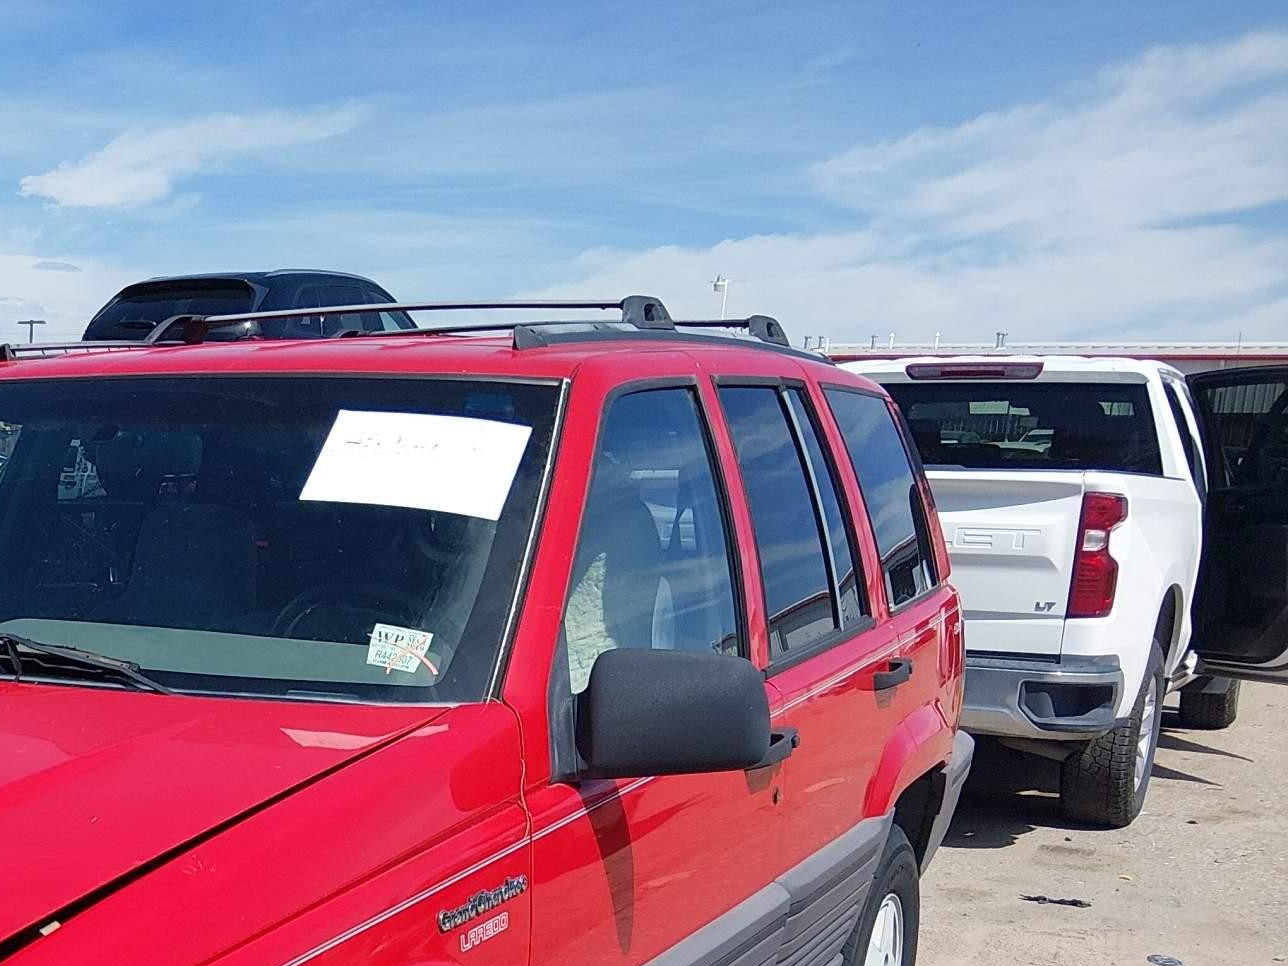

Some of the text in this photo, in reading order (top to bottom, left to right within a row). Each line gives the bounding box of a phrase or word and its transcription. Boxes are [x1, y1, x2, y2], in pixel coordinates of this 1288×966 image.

[945, 527, 1041, 550] ET
[1033, 601, 1057, 613] LT
[460, 912, 509, 953] LAREDO
